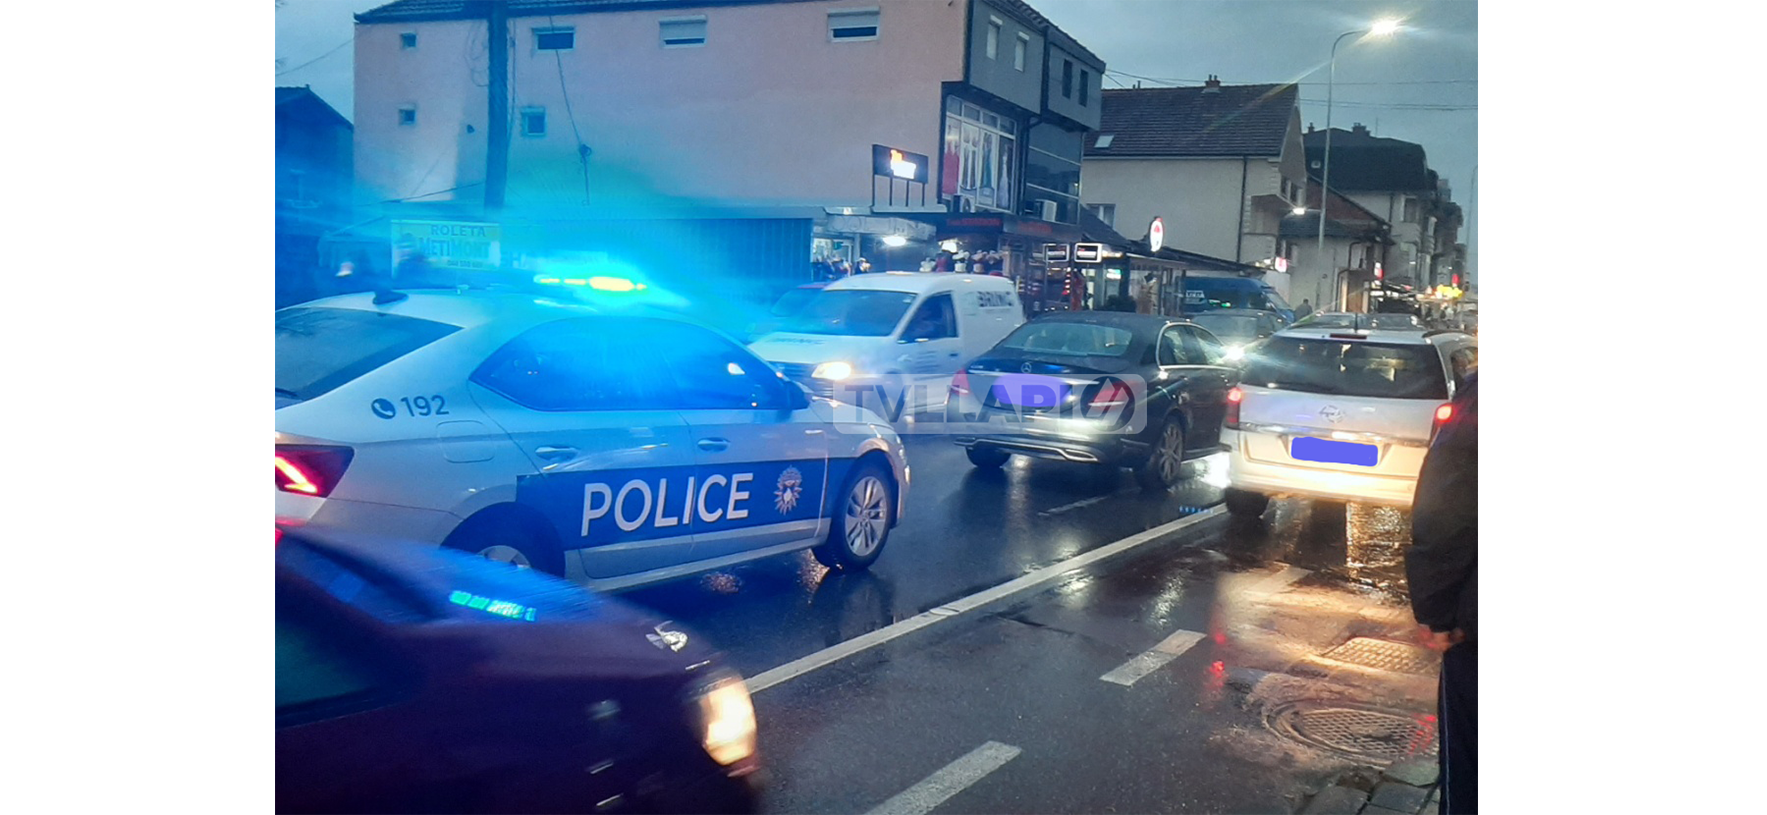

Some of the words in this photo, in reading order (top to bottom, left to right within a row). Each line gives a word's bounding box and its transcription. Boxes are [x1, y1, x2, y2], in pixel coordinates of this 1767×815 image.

[429, 224, 487, 237] ROLETA
[400, 395, 450, 417] 192
[581, 472, 754, 537] POLICE
